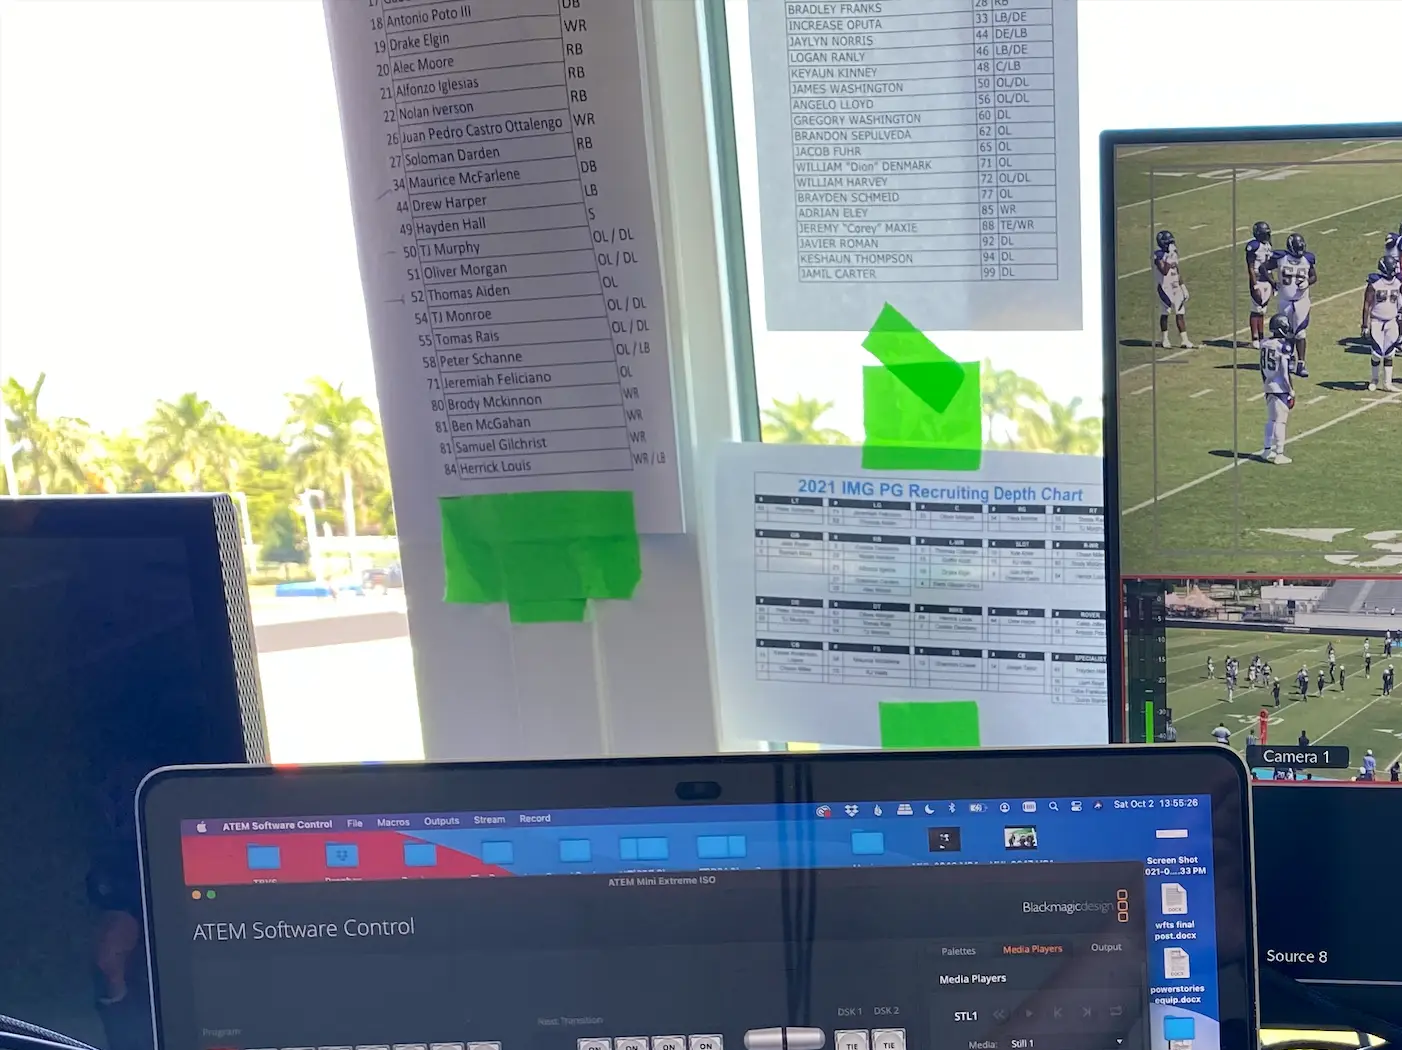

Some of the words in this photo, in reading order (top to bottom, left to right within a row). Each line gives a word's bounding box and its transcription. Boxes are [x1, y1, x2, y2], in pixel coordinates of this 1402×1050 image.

[995, 11, 1027, 23] LB/DE
[564, 19, 587, 32] WR
[789, 20, 843, 31] INCREASE
[847, 19, 882, 30] OPUTA
[389, 37, 421, 52] Drake
[423, 32, 450, 49] Elgin
[566, 44, 583, 56] RB
[790, 52, 827, 63] LOGAN
[831, 51, 865, 62] RANLY
[377, 64, 390, 76] 20
[393, 59, 415, 74] Alec
[418, 56, 454, 71] Moore
[792, 83, 827, 94] JAMES
[830, 82, 903, 94] WASHINGTON
[402, 130, 426, 144] Juan
[428, 126, 463, 141] Pedro
[466, 122, 503, 138] Castro
[505, 116, 563, 134] Ottalengo
[794, 130, 847, 141] BRANDON
[852, 129, 911, 141] SEPULVEDA
[980, 126, 991, 136] 62
[998, 125, 1012, 136] OL
[389, 156, 401, 168] 27
[405, 151, 454, 167] Soloman
[457, 147, 500, 161] Darden
[409, 175, 456, 189] Maurice
[459, 168, 521, 185] McFarlene
[798, 192, 847, 203] BRAYDEN
[851, 191, 899, 202] SCHMEID
[416, 221, 459, 238] Hayden
[462, 218, 486, 231] Hall
[801, 254, 850, 264] KESHAUN
[854, 253, 913, 264] THOMPSON
[424, 264, 457, 280] Oliver
[459, 262, 508, 279] Morgan
[443, 376, 495, 391] Jeremiah
[497, 371, 552, 387] Feliciano
[455, 440, 496, 455] Samuel
[498, 436, 548, 452] Gilchrist
[459, 461, 499, 475] Herrick
[501, 459, 532, 472] Louis
[798, 479, 837, 495] 2021
[842, 481, 875, 496] IMG
[880, 482, 903, 497] PG
[909, 484, 989, 504] Recruiting
[994, 486, 1036, 505] Depth
[1041, 486, 1083, 502] Chart
[1263, 750, 1318, 764] Camera
[1323, 751, 1330, 763] 1
[1114, 800, 1129, 809] Sat
[1131, 800, 1146, 809] Oct
[1148, 799, 1154, 808] 2
[222, 822, 249, 831] ATEM
[252, 820, 295, 831] Software
[297, 819, 333, 829] Control
[347, 819, 363, 828] File
[377, 818, 410, 827] Macros
[424, 816, 460, 827] Outputs
[474, 815, 506, 824] Stream
[519, 813, 551, 823] Record
[608, 878, 635, 887] ATEM
[637, 877, 656, 886] Mini
[658, 876, 697, 886] Extreme
[1023, 901, 1114, 914] Blackmagicdesign
[193, 922, 247, 941] ATEM
[253, 920, 338, 940] Software
[344, 917, 415, 937] Control
[1003, 945, 1030, 954] Media
[1032, 944, 1063, 954] Players
[1267, 950, 1314, 963] Source
[1319, 951, 1328, 963] 8
[1150, 985, 1205, 994] powerstories
[954, 1011, 977, 1021] STL1
